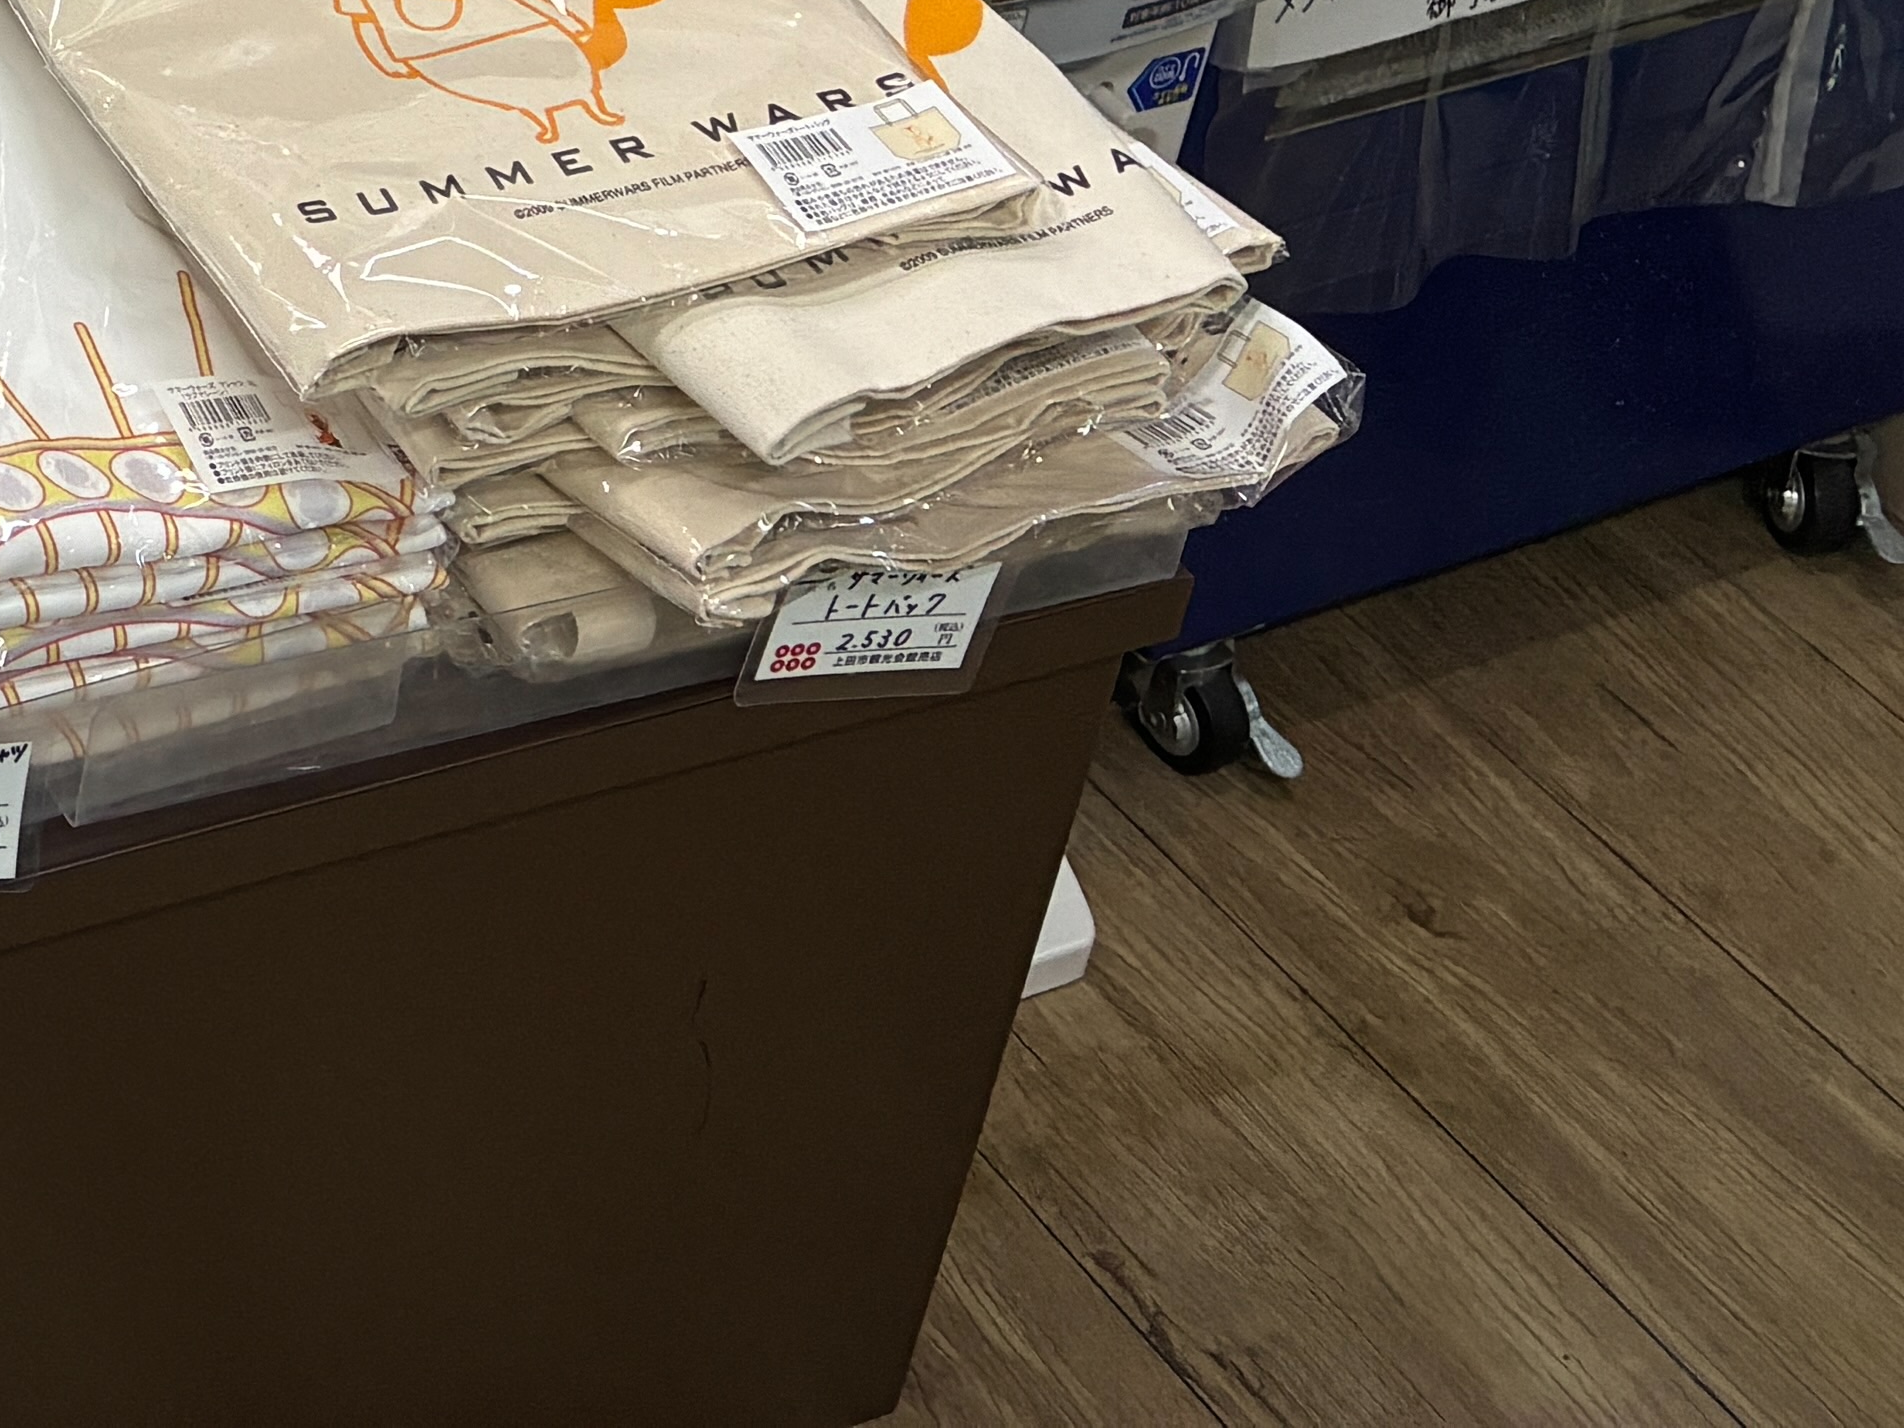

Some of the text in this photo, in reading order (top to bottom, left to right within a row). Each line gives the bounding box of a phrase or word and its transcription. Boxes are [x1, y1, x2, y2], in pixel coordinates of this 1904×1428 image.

[692, 69, 918, 142] WARS
[297, 134, 656, 224] SUMMER
[651, 171, 681, 192] FILM
[1045, 203, 1115, 236] PARTNERS
